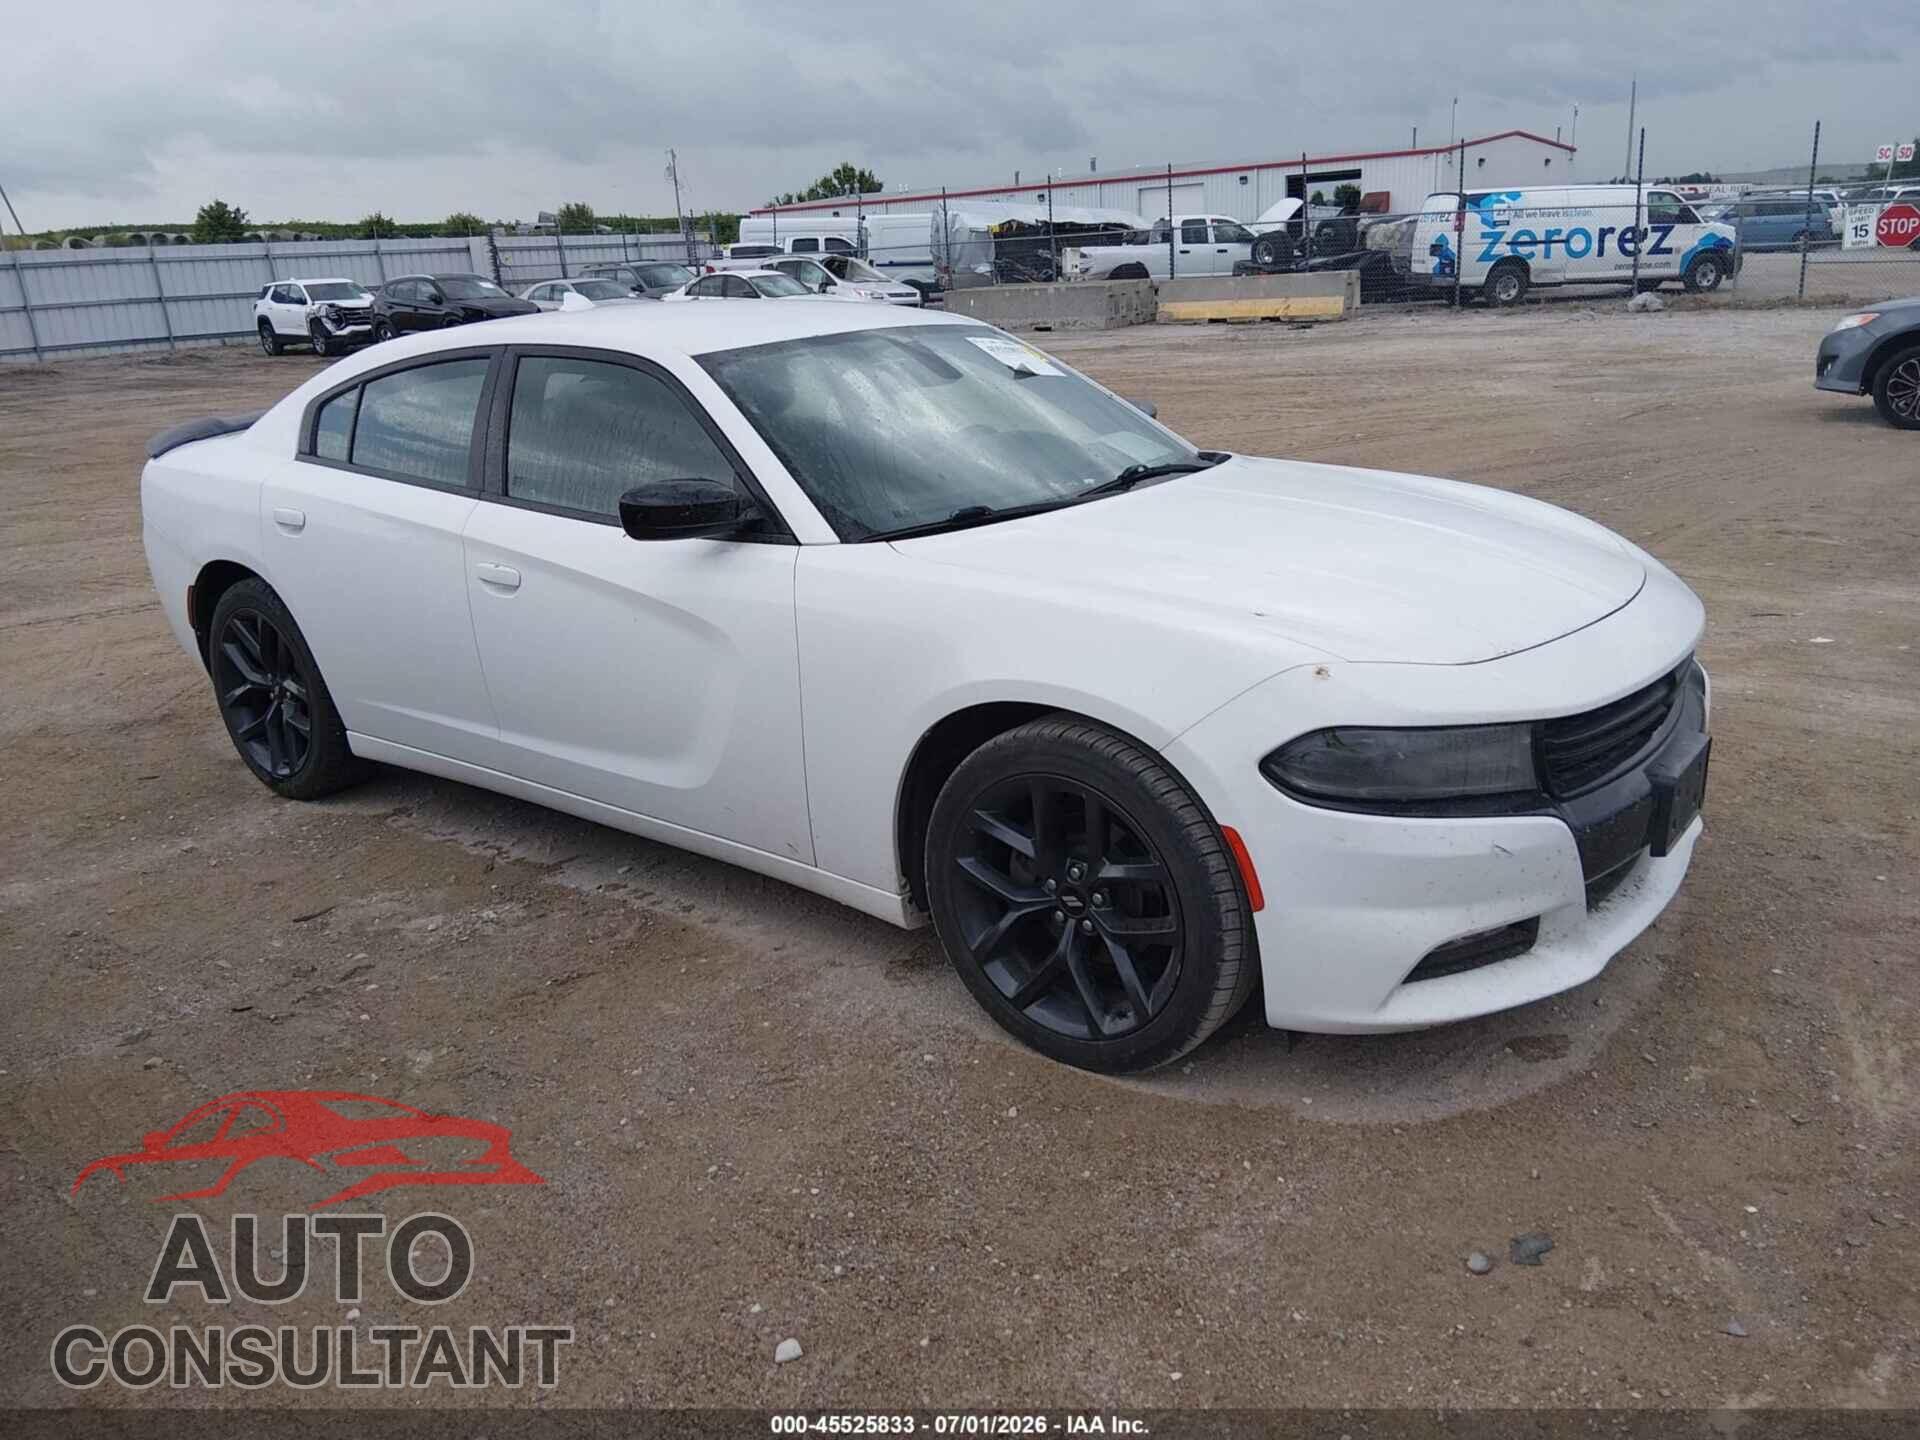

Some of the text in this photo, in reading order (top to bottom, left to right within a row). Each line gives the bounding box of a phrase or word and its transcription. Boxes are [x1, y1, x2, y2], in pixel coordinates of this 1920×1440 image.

[1539, 208, 1561, 217] leave
[1848, 207, 1874, 215] SPEED
[1850, 215, 1871, 223] LIMIT
[1852, 224, 1869, 238] 15
[1878, 217, 1920, 234] STOP
[1476, 225, 1674, 262] zerorez
